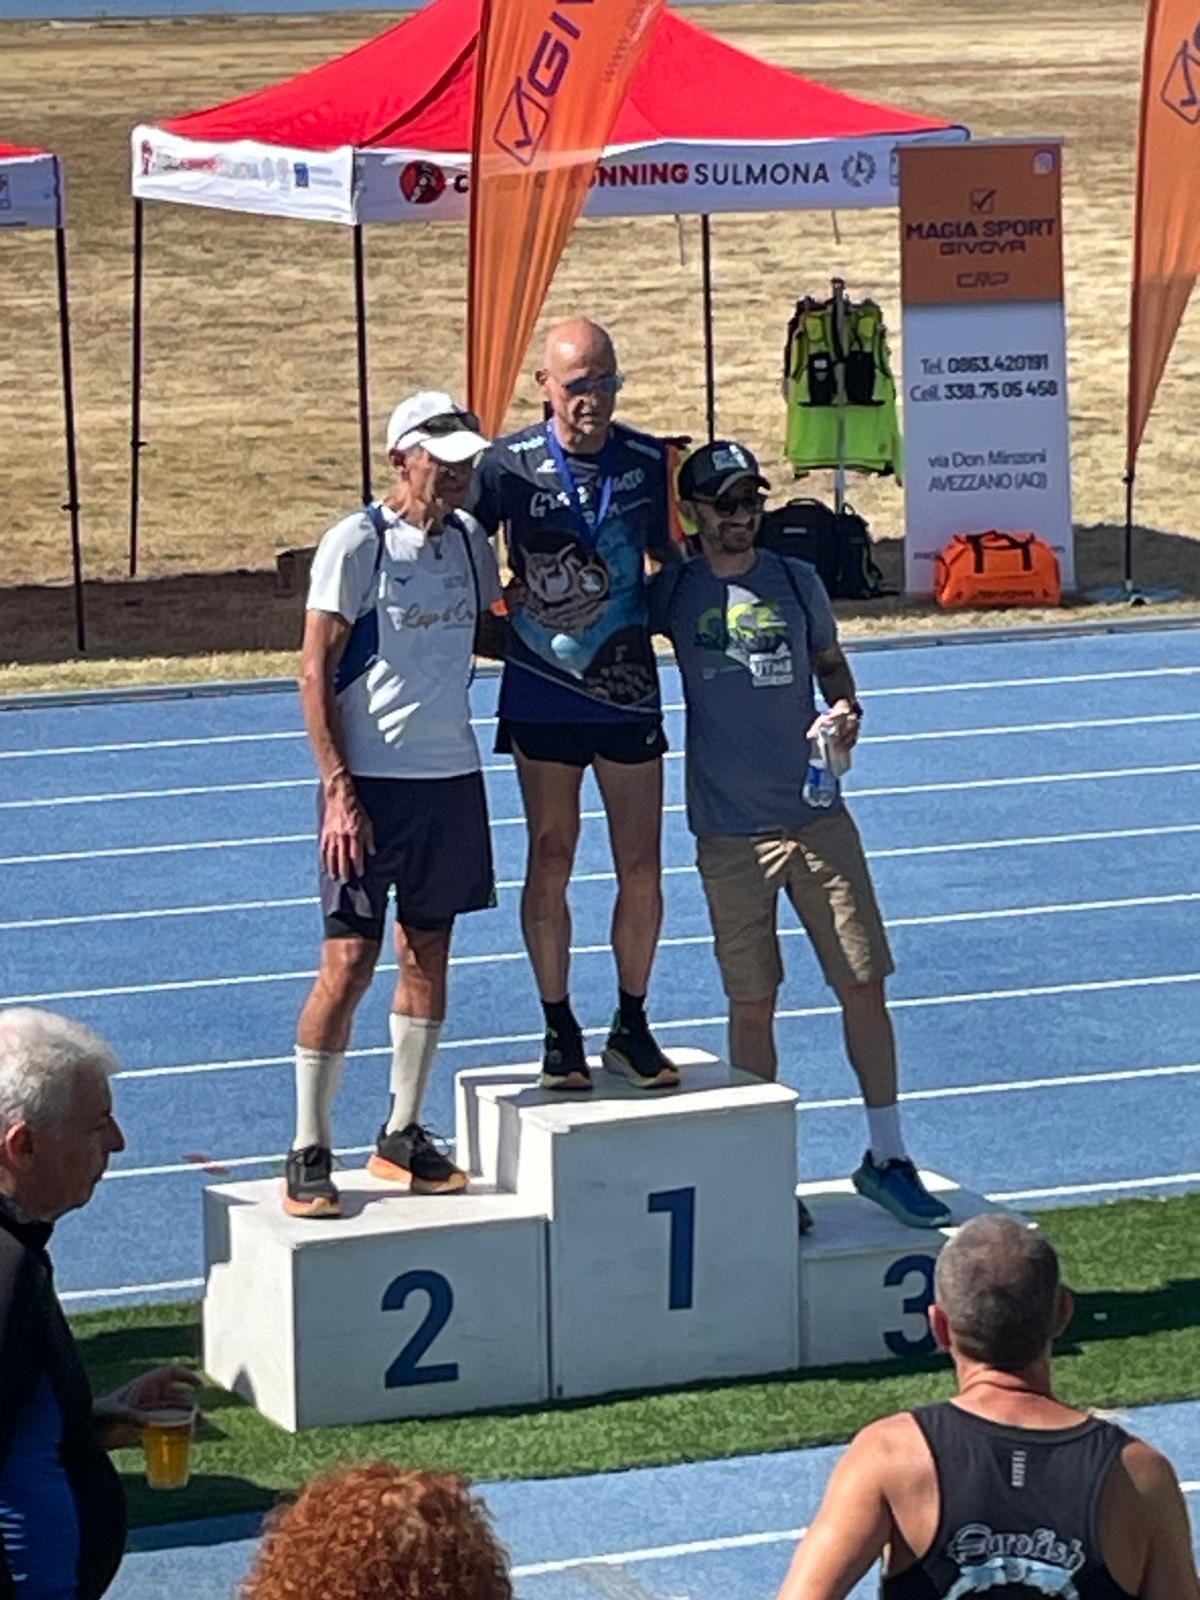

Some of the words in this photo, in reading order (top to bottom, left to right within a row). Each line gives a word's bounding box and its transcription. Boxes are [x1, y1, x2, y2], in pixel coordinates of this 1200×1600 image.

[694, 163, 830, 185] SULMONA
[906, 221, 977, 240] MAGIA
[983, 218, 1056, 237] SPORT
[928, 473, 1012, 492] AVEZZANO
[647, 1186, 696, 1310] 1
[380, 1269, 459, 1388] 2
[882, 1255, 938, 1358] 3
